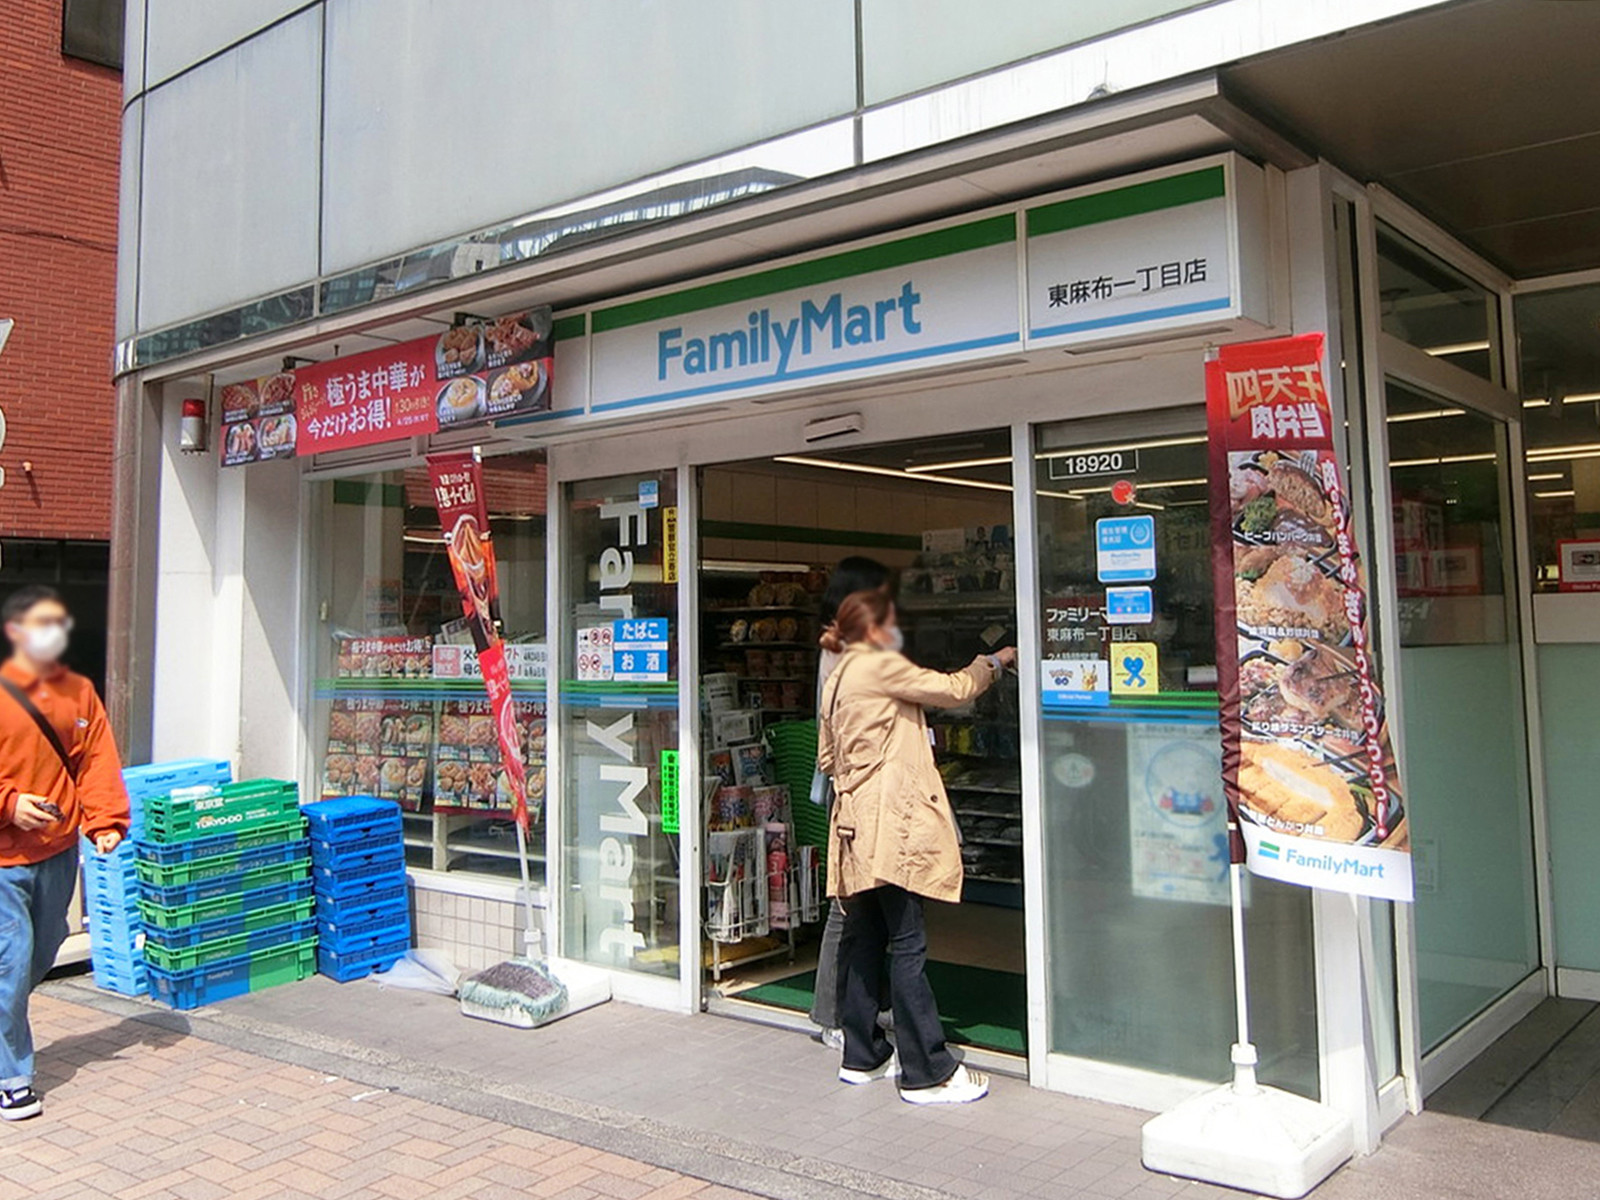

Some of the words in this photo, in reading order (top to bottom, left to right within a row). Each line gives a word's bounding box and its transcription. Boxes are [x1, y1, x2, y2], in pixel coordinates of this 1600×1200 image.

[1048, 259, 1207, 308] 東麻布一丁目店
[657, 281, 922, 381] FamilyMart
[326, 361, 426, 409] 極うま中華が
[1226, 361, 1329, 421] 四天王
[307, 397, 392, 440] 今だけお得!
[1251, 403, 1326, 439] 肉弁当
[1065, 452, 1123, 475] 18920
[622, 622, 660, 640] たばこ
[1047, 626, 1137, 642] 東麻布一丁目店
[1286, 849, 1384, 878] FamilyMart
